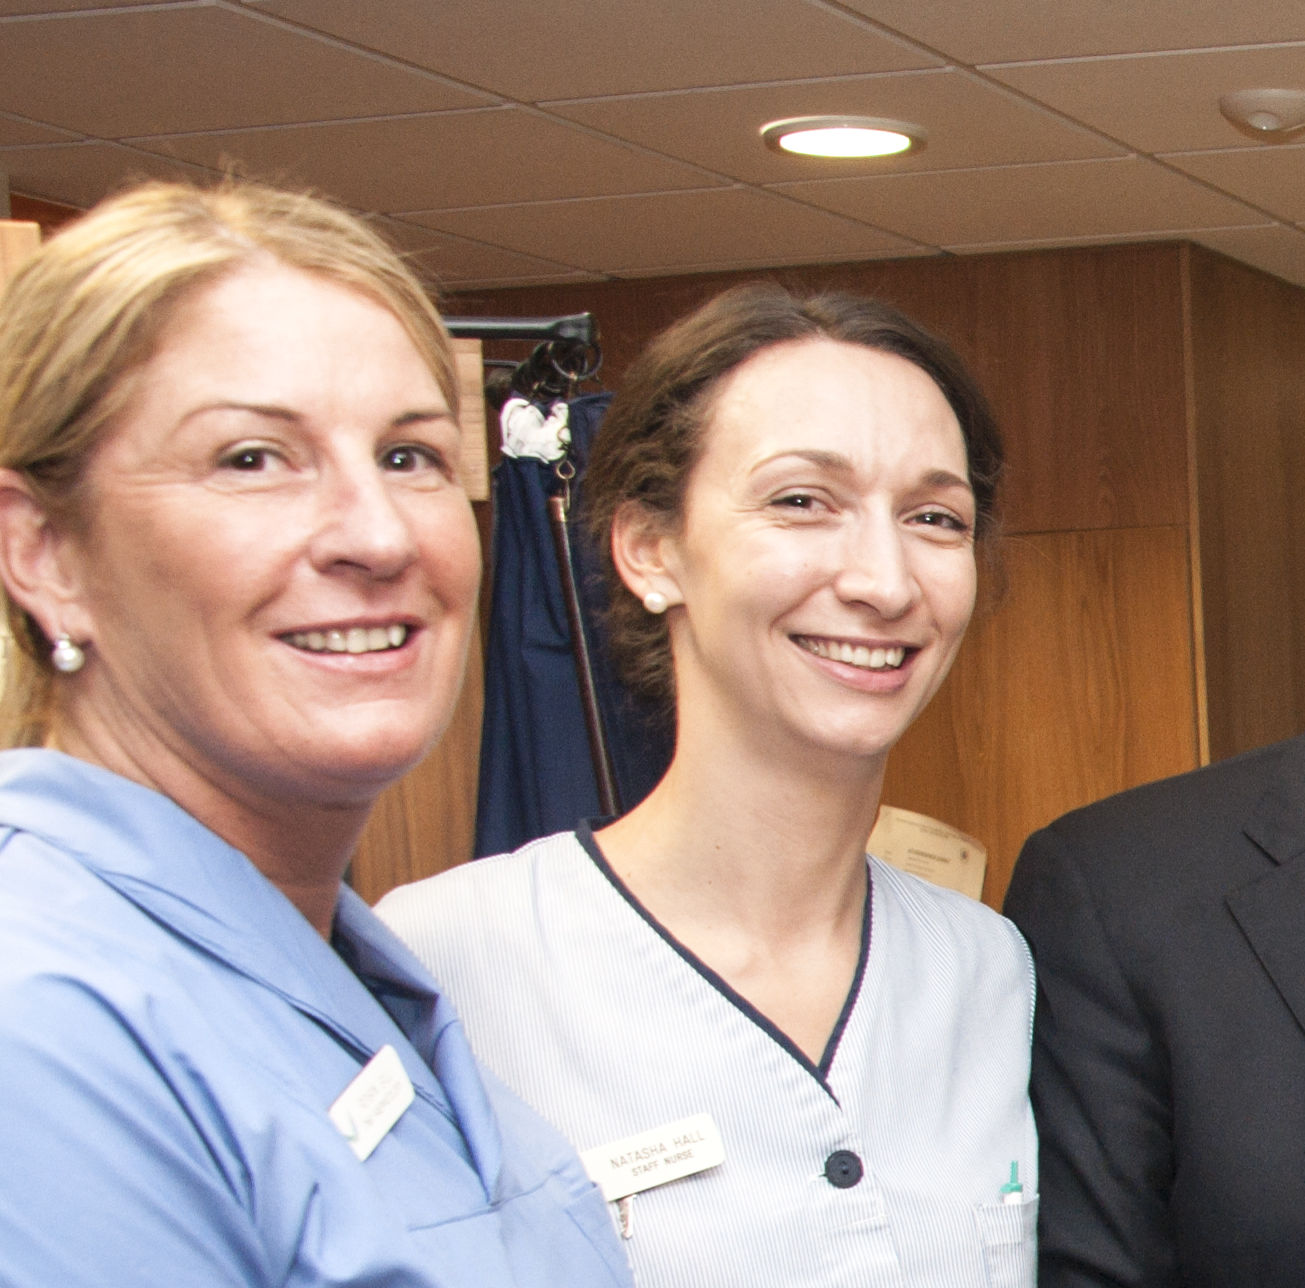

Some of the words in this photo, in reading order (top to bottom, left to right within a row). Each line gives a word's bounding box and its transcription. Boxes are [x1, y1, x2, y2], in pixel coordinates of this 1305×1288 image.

[610, 1143, 667, 1169] NATASHA
[673, 1130, 705, 1148] HALL
[632, 1160, 658, 1177] STAFF
[663, 1149, 694, 1166] NURSE
